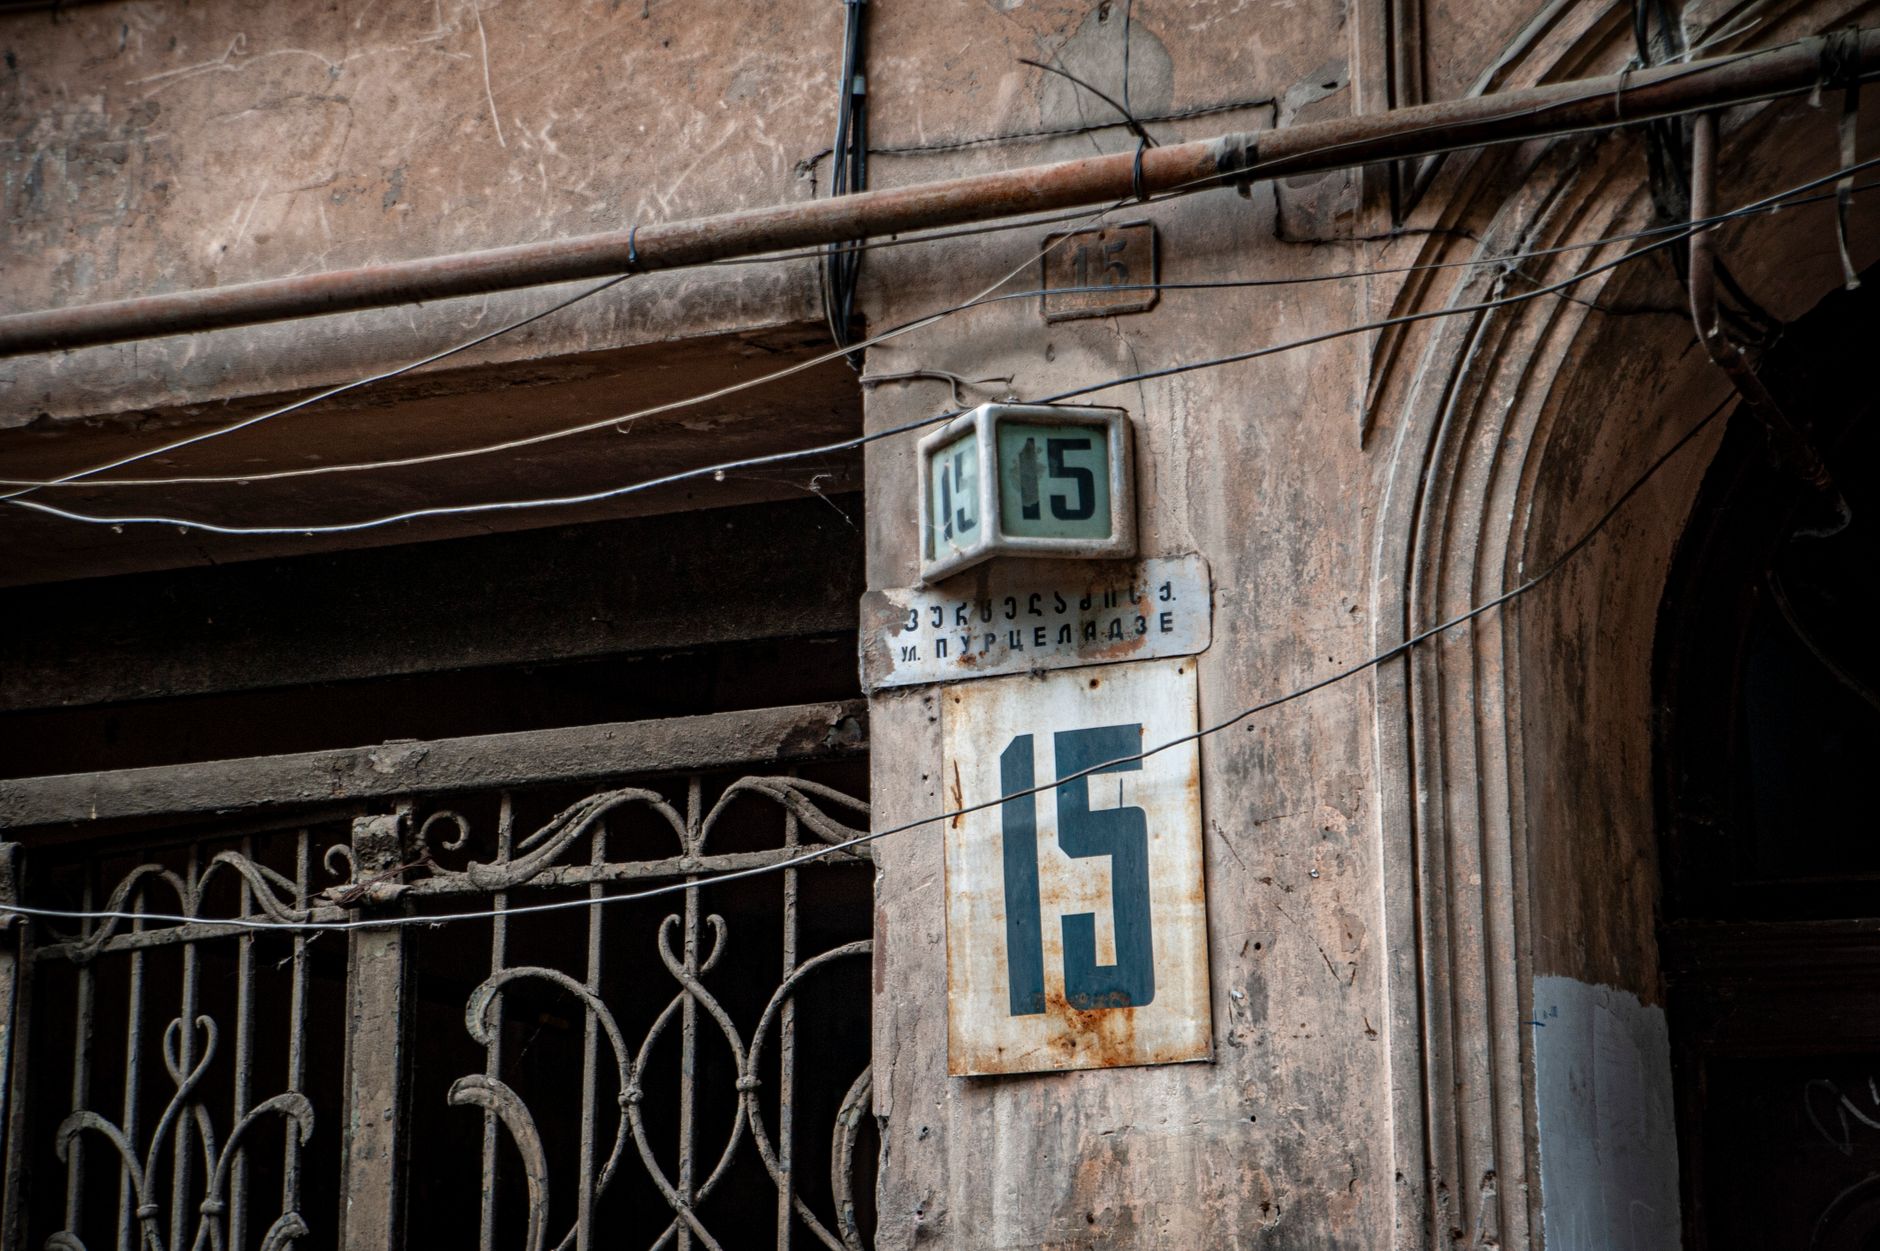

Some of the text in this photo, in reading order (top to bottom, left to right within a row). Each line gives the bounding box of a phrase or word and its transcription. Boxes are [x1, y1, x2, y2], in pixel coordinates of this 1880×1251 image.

[1072, 240, 1129, 289] 15
[1019, 437, 1096, 520] 15
[935, 611, 1174, 658] ПУРЦЕЛАДЗЕ
[1000, 723, 1155, 1016] 15
